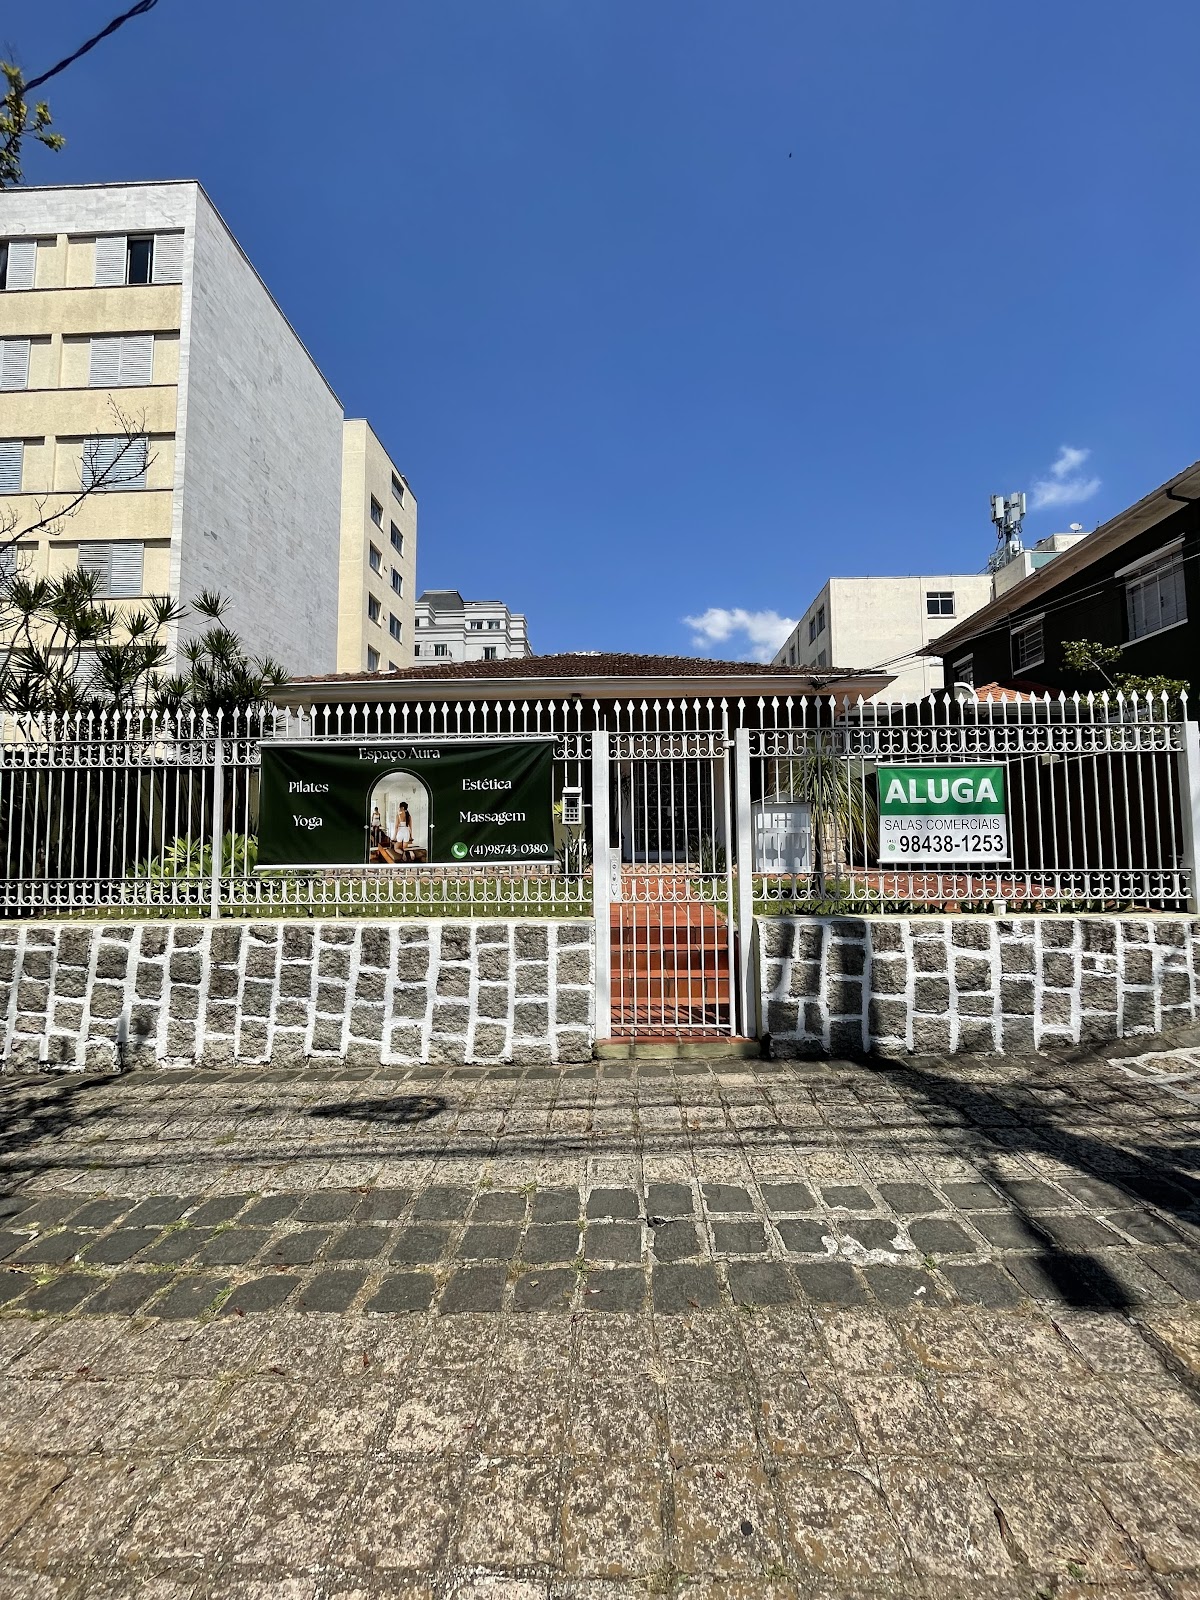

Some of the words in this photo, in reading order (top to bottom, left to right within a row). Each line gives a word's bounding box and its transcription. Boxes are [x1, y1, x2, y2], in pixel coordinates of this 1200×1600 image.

[359, 748, 406, 763] Espaço
[409, 746, 440, 760] Aura
[288, 780, 329, 793] Pilates
[462, 778, 512, 791] Estética
[885, 778, 998, 803] ALUGA
[293, 814, 323, 830] Yoga
[459, 810, 526, 826] Massagem
[885, 819, 922, 830] SALAS
[926, 818, 1000, 830] COMERCIAIS
[900, 835, 1003, 852] 98438-1253
